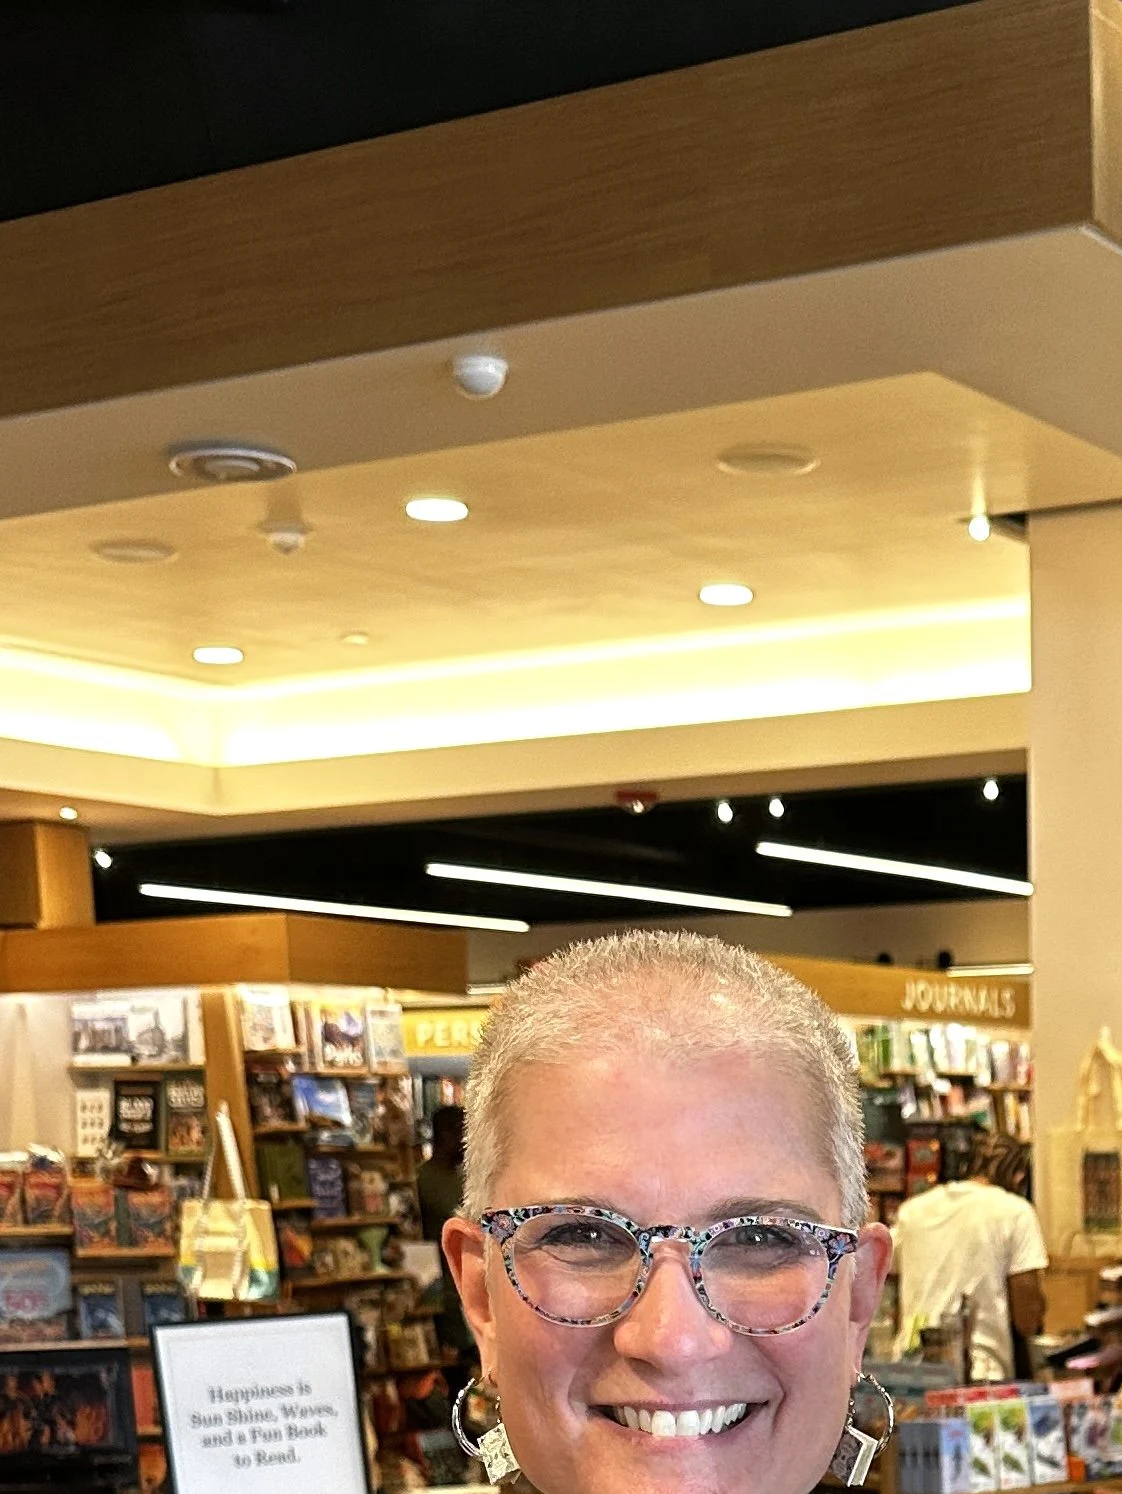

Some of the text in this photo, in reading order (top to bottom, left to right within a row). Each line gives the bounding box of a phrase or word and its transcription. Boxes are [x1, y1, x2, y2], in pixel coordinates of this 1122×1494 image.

[901, 979, 1016, 1018] JOURNALS
[208, 1378, 312, 1404] Happiness is
[191, 1402, 338, 1428] Sun Shine, Waves,
[202, 1420, 328, 1448] and a Fun Book
[233, 1445, 301, 1469] to Read.
